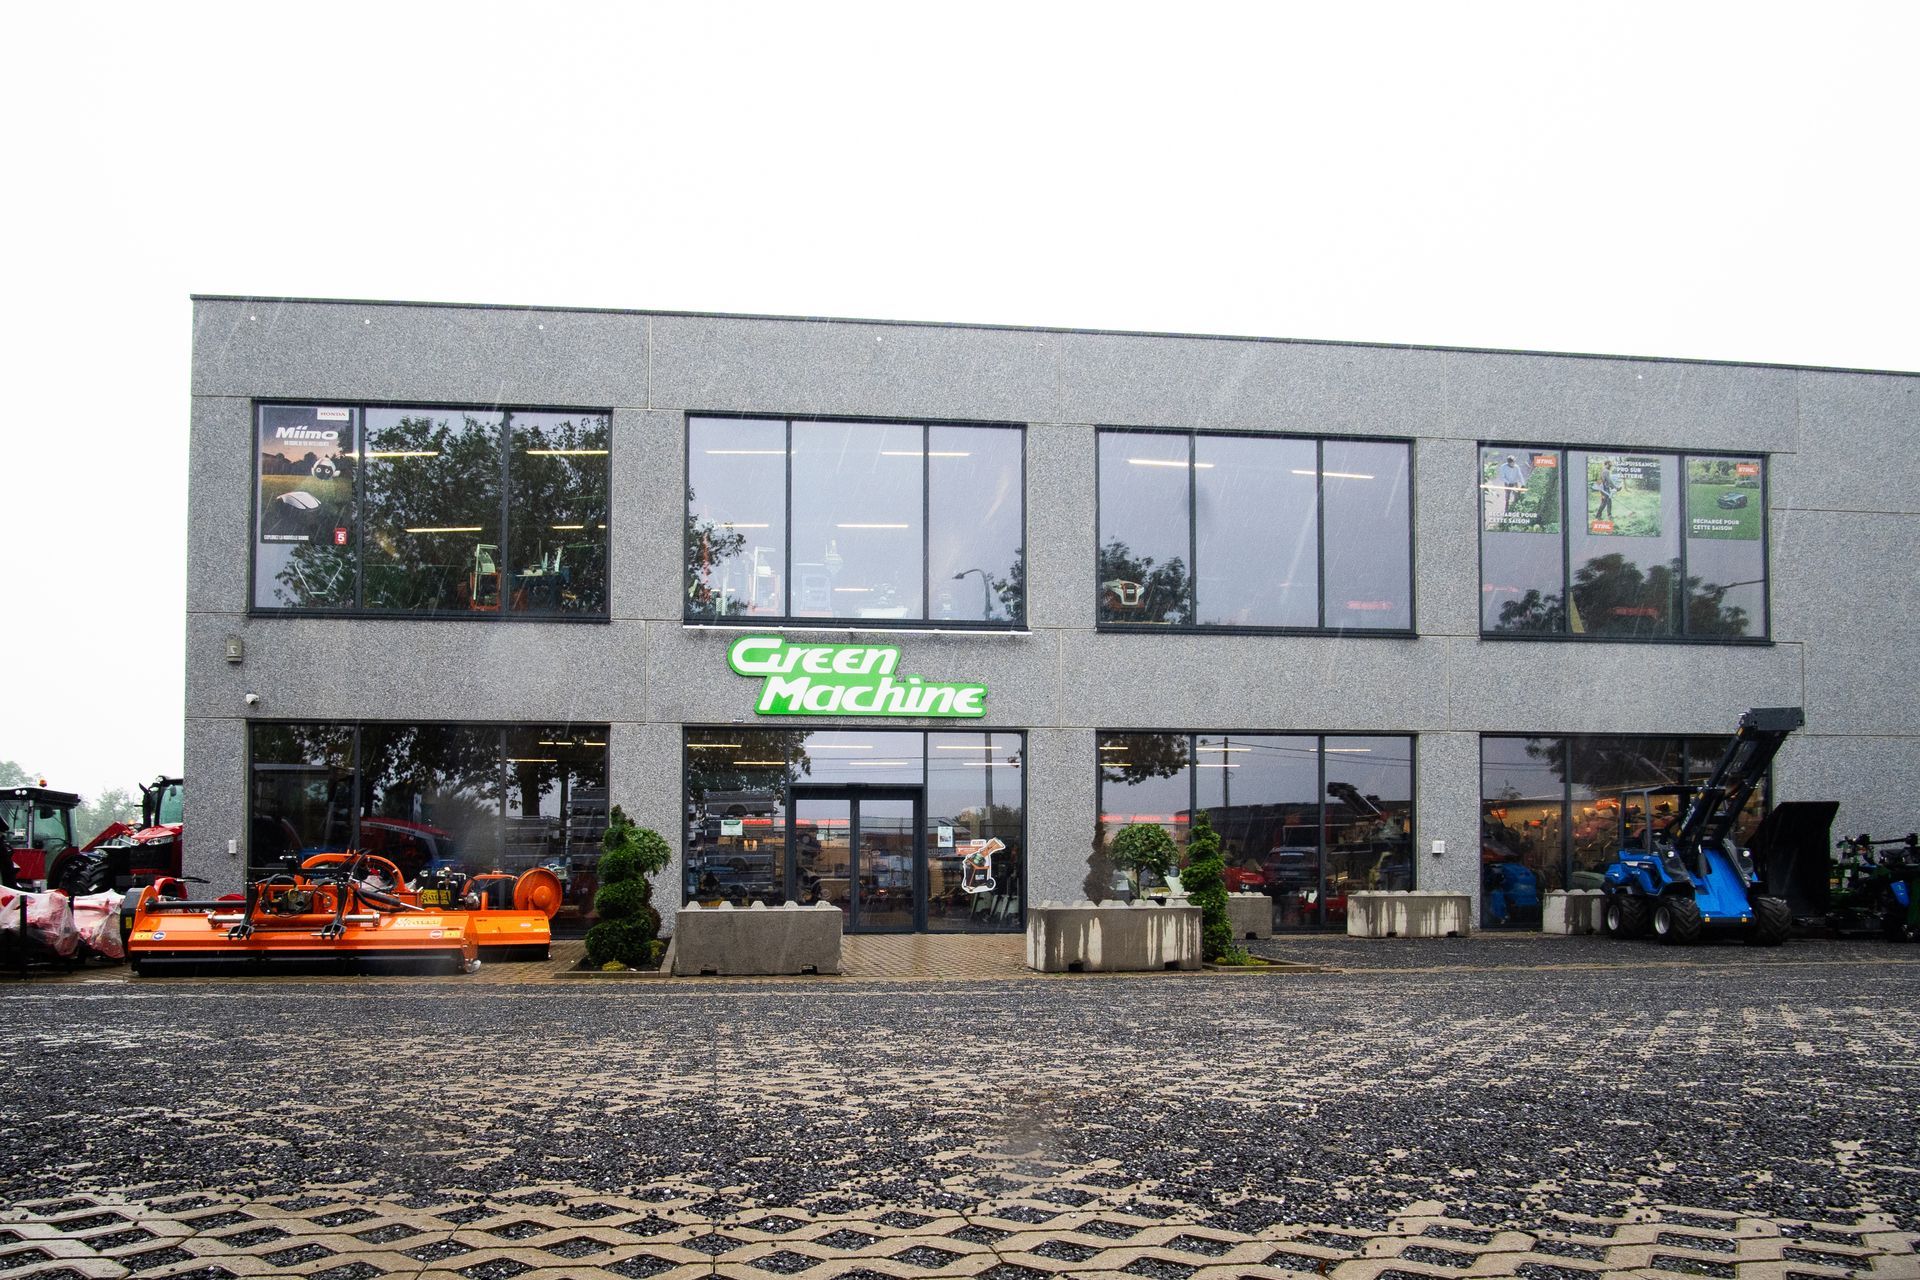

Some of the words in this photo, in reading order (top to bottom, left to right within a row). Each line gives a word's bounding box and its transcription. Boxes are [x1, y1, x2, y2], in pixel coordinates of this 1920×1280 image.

[275, 425, 339, 440] Miimo
[731, 637, 899, 675] Green
[758, 676, 986, 713] Machine
